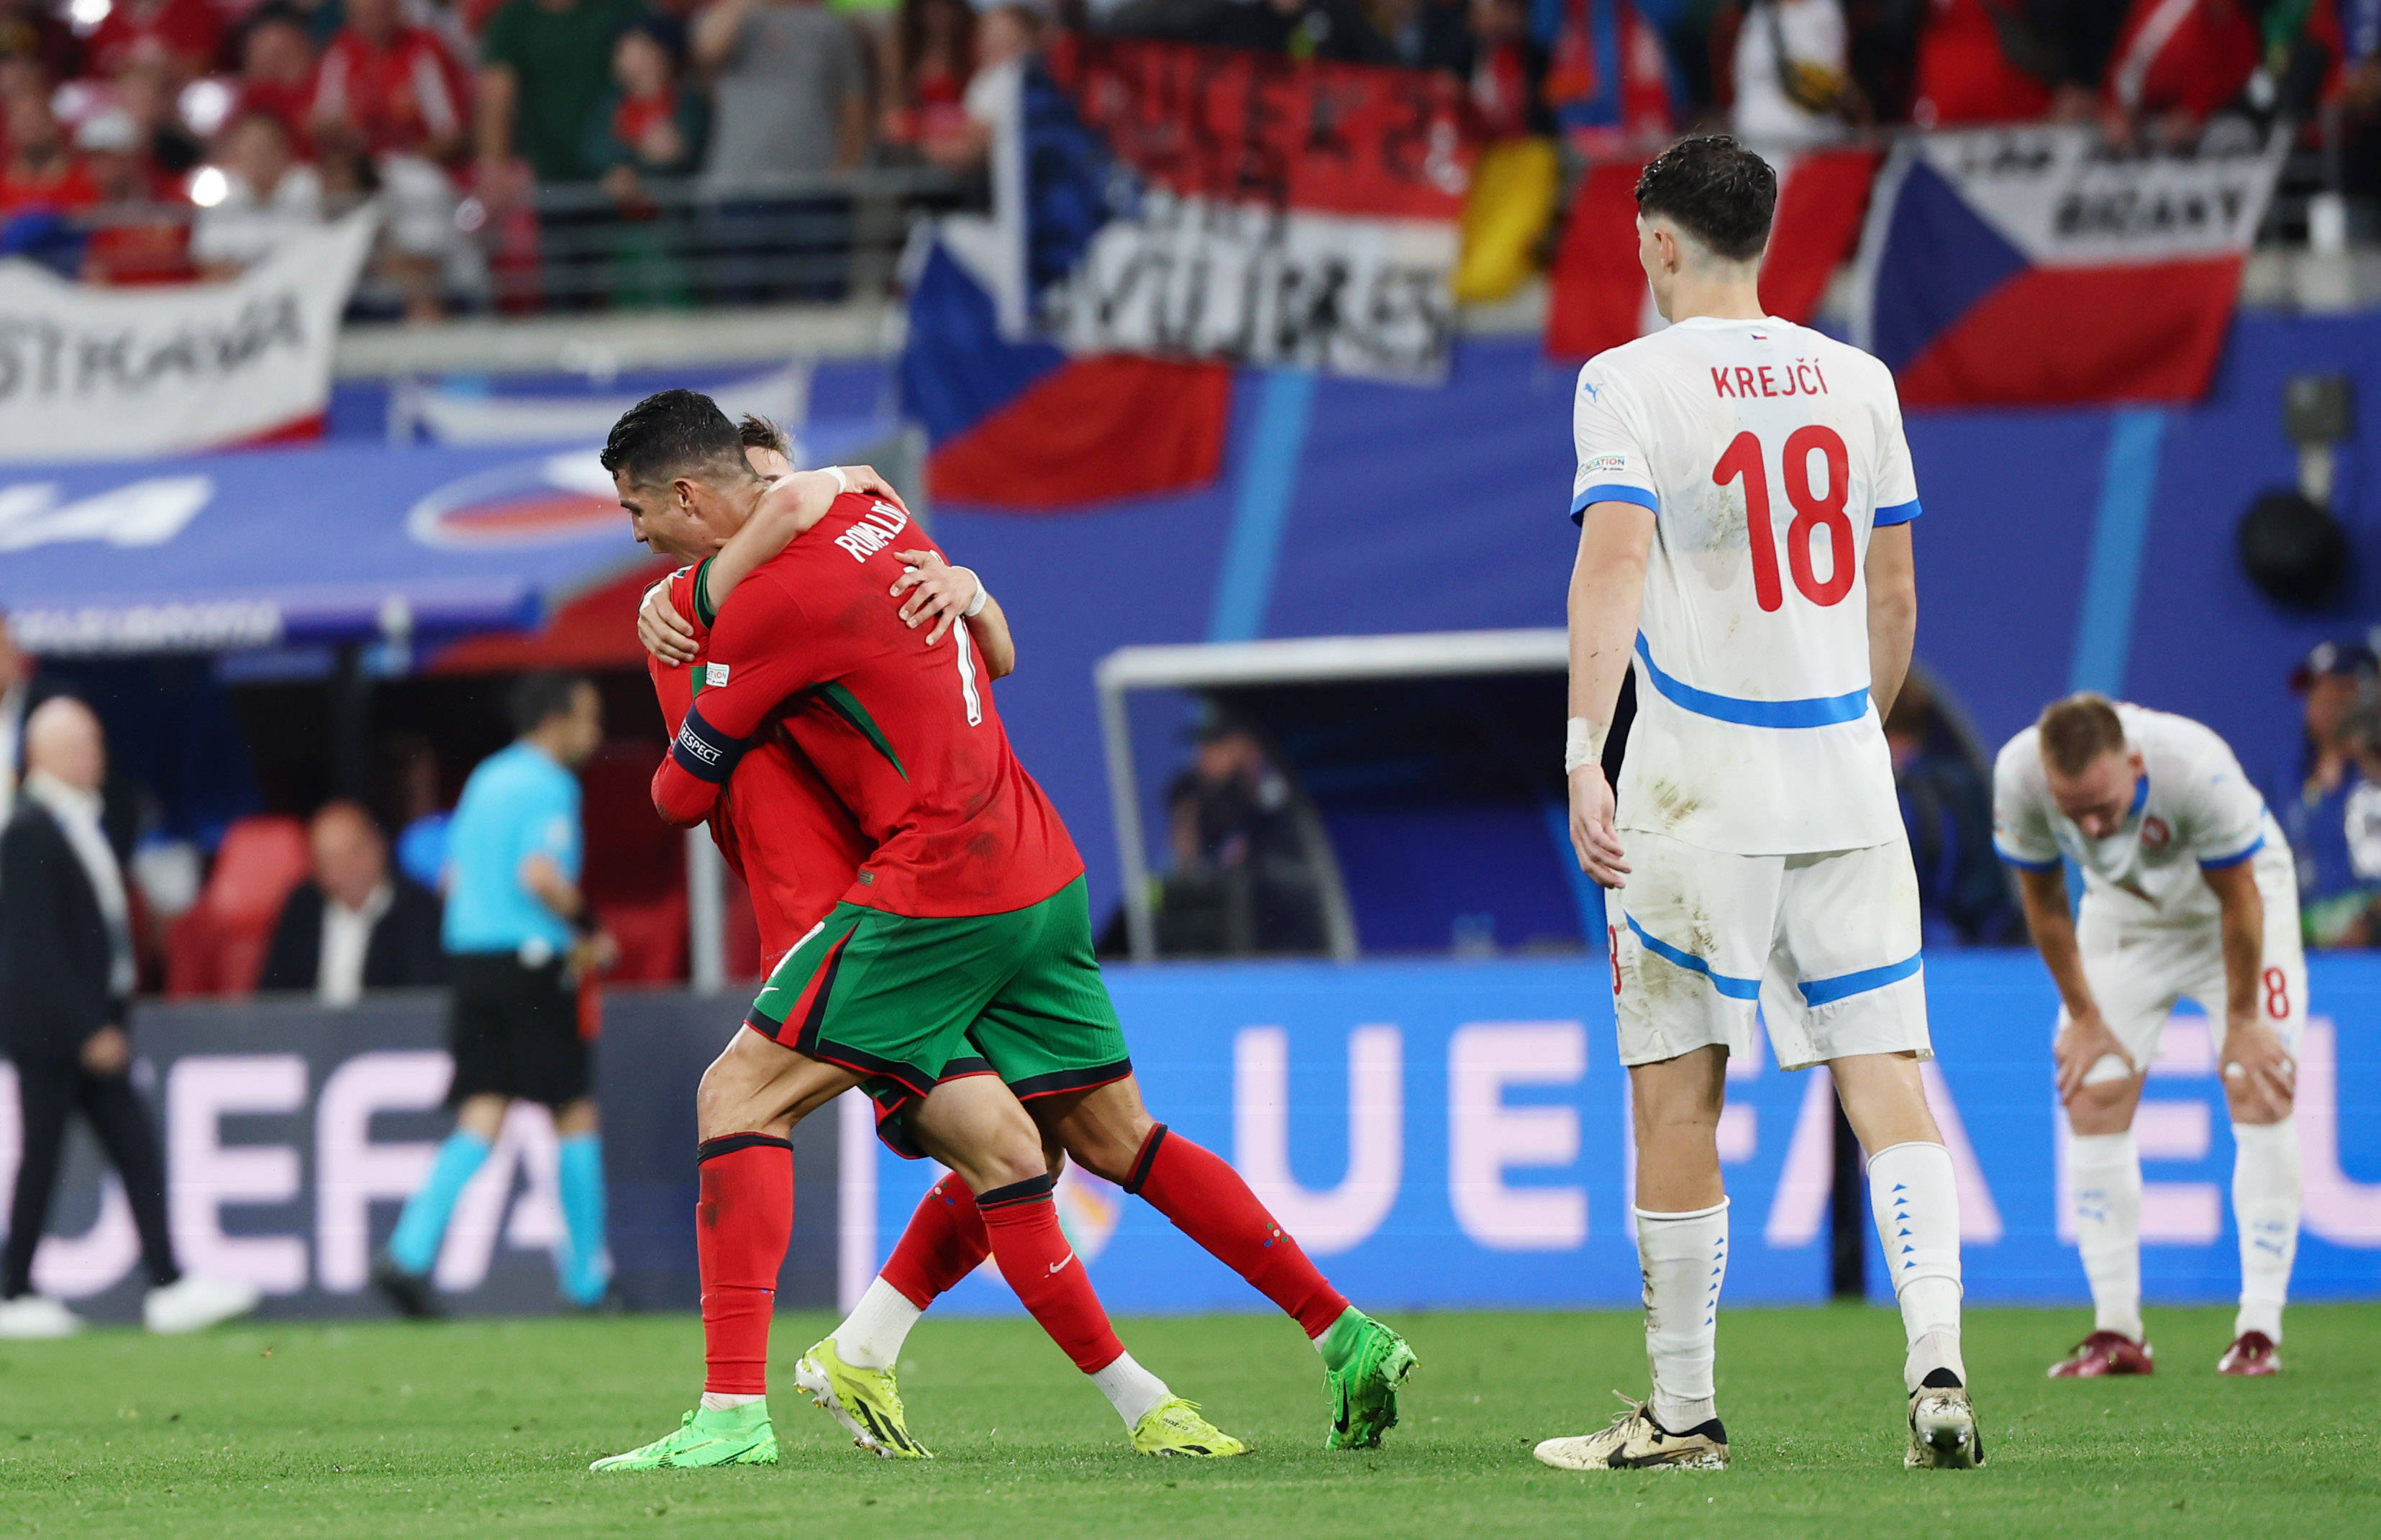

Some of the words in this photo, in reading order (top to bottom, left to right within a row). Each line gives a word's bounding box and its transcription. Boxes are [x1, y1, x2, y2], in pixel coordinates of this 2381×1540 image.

[1711, 357, 1828, 398] KREJČÍ
[834, 500, 909, 564] RONALD
[1712, 424, 1856, 612] 18
[680, 726, 721, 762] RESPECT
